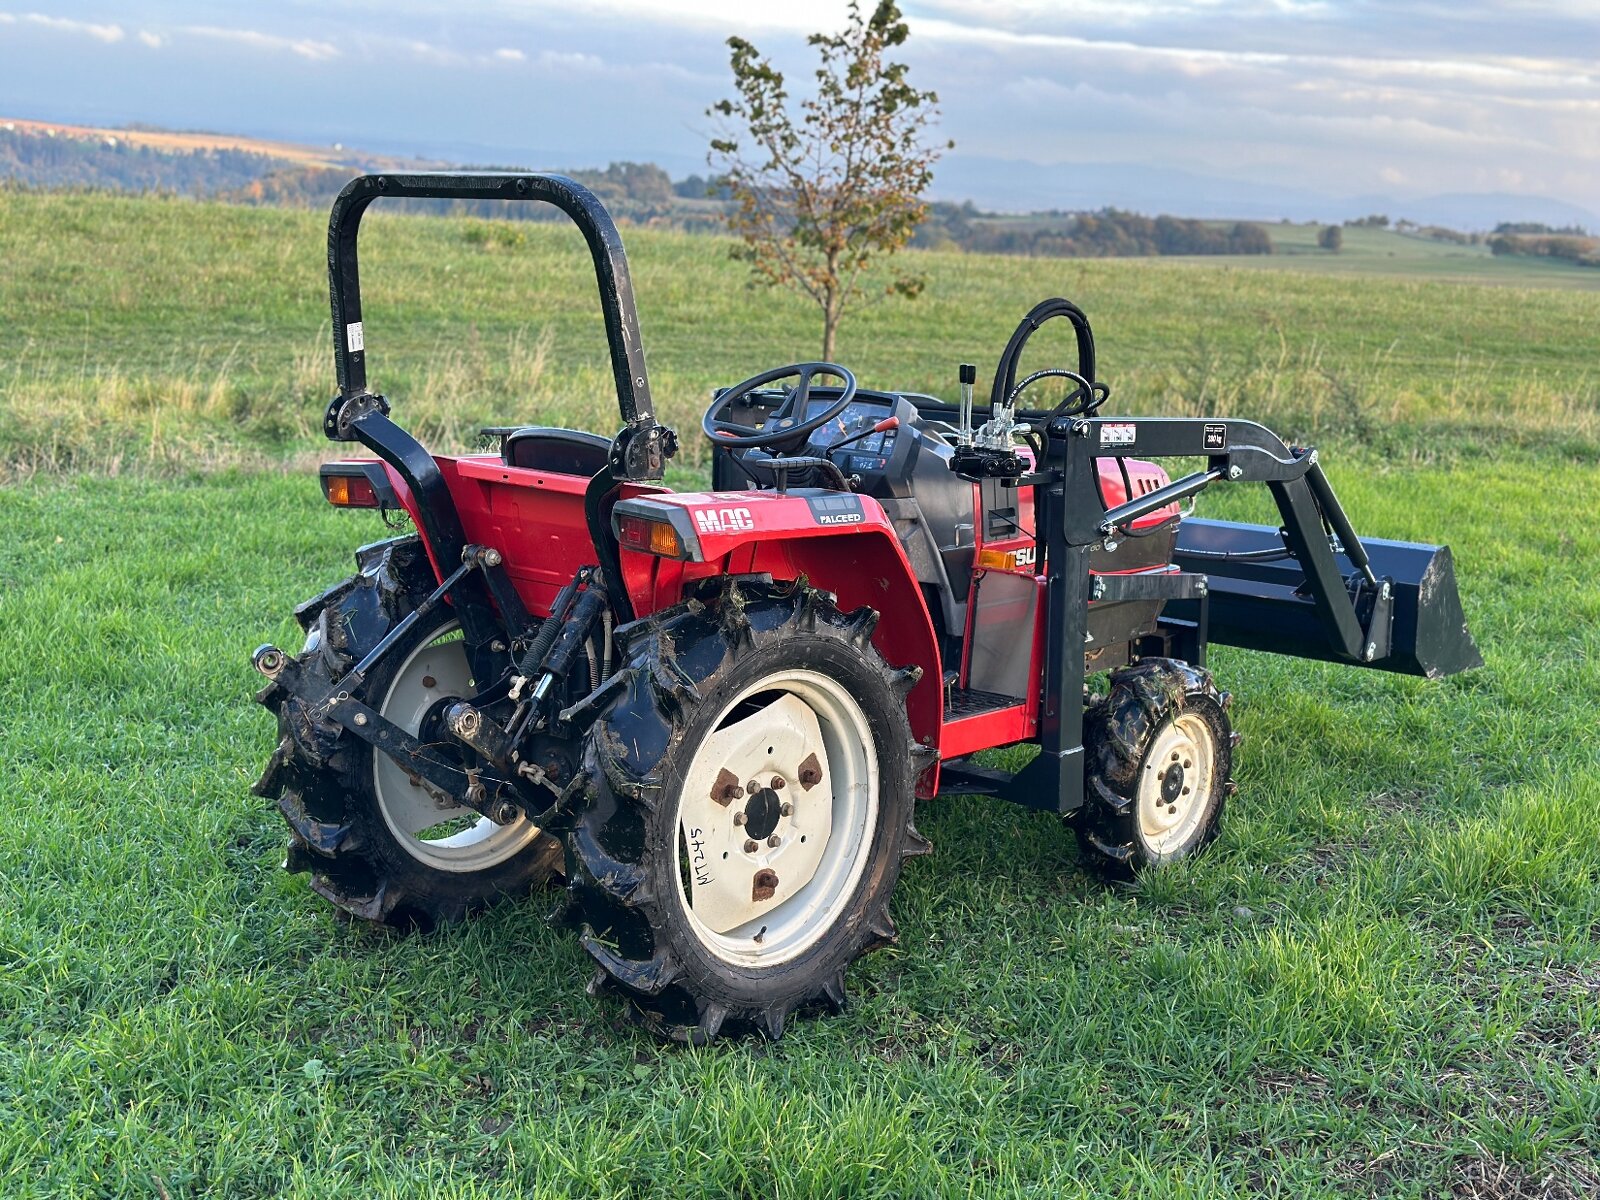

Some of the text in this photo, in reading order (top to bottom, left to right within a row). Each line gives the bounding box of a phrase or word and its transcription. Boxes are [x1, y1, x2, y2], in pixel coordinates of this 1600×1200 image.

[694, 507, 754, 533] MAC
[819, 513, 861, 524] PALCEED
[690, 828, 715, 886] MT245
